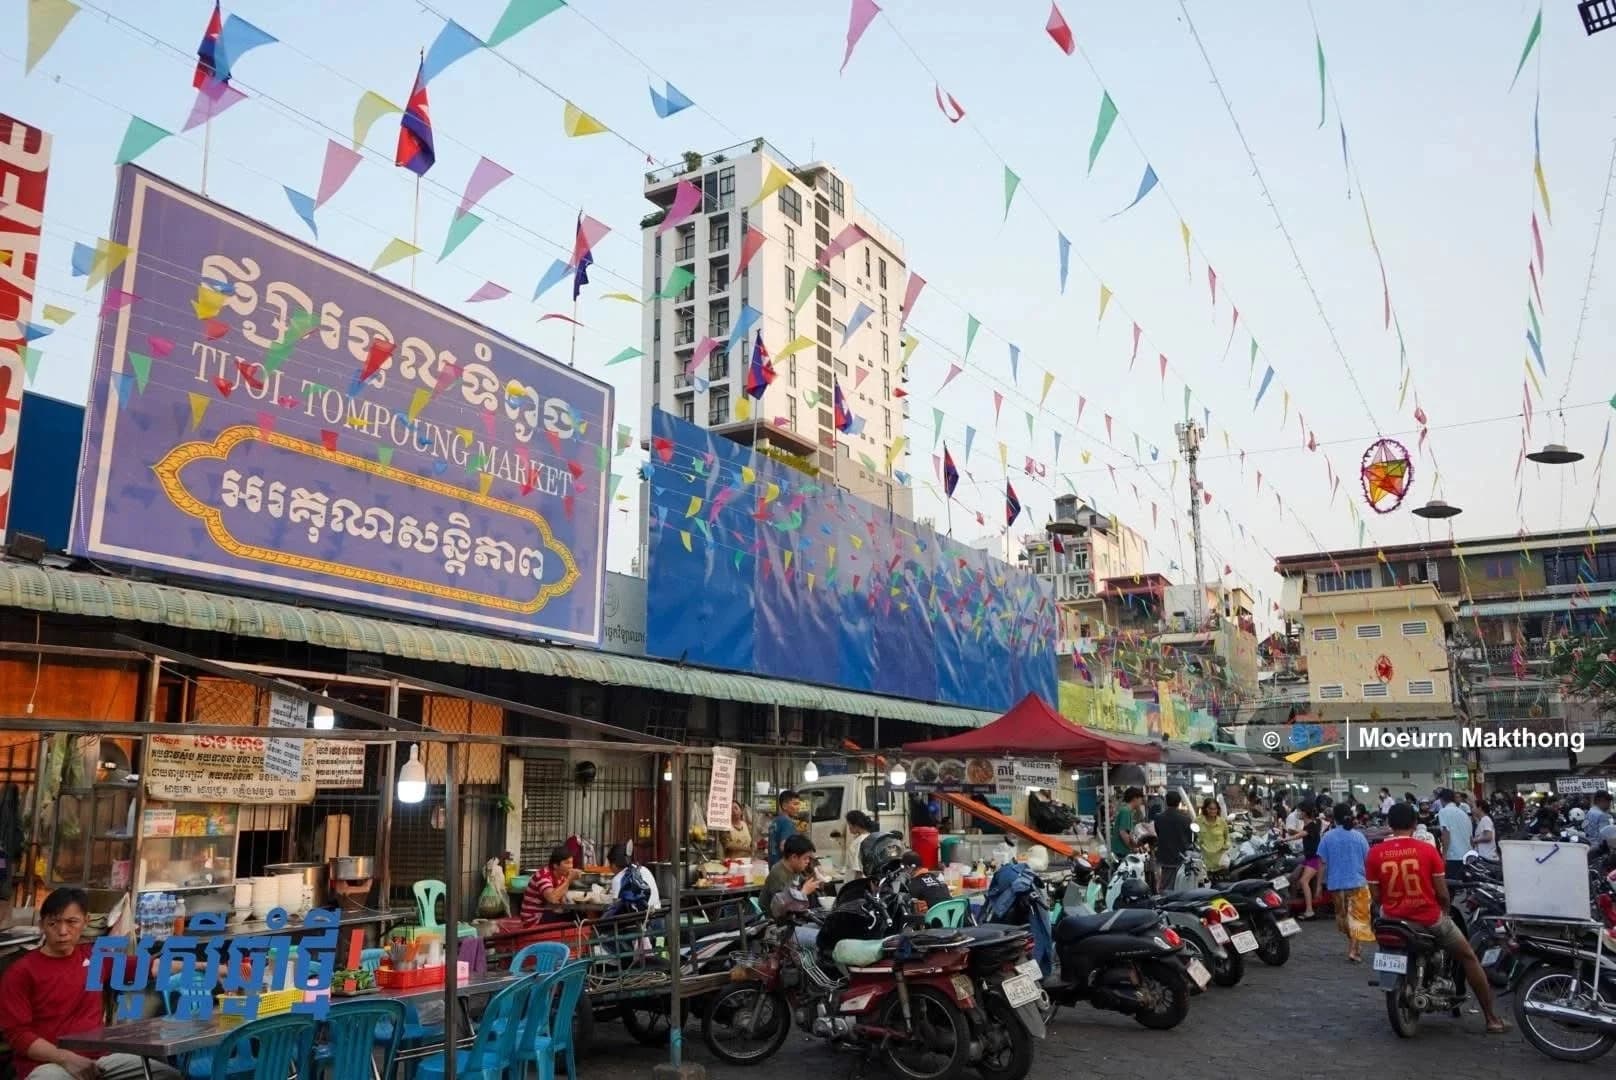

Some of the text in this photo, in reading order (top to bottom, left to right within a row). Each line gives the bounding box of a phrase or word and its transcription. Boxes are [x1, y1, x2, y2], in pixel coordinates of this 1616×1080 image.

[192, 342, 574, 498] TUOL TOMPOUNG MARKET
[1381, 858, 1423, 897] 26
